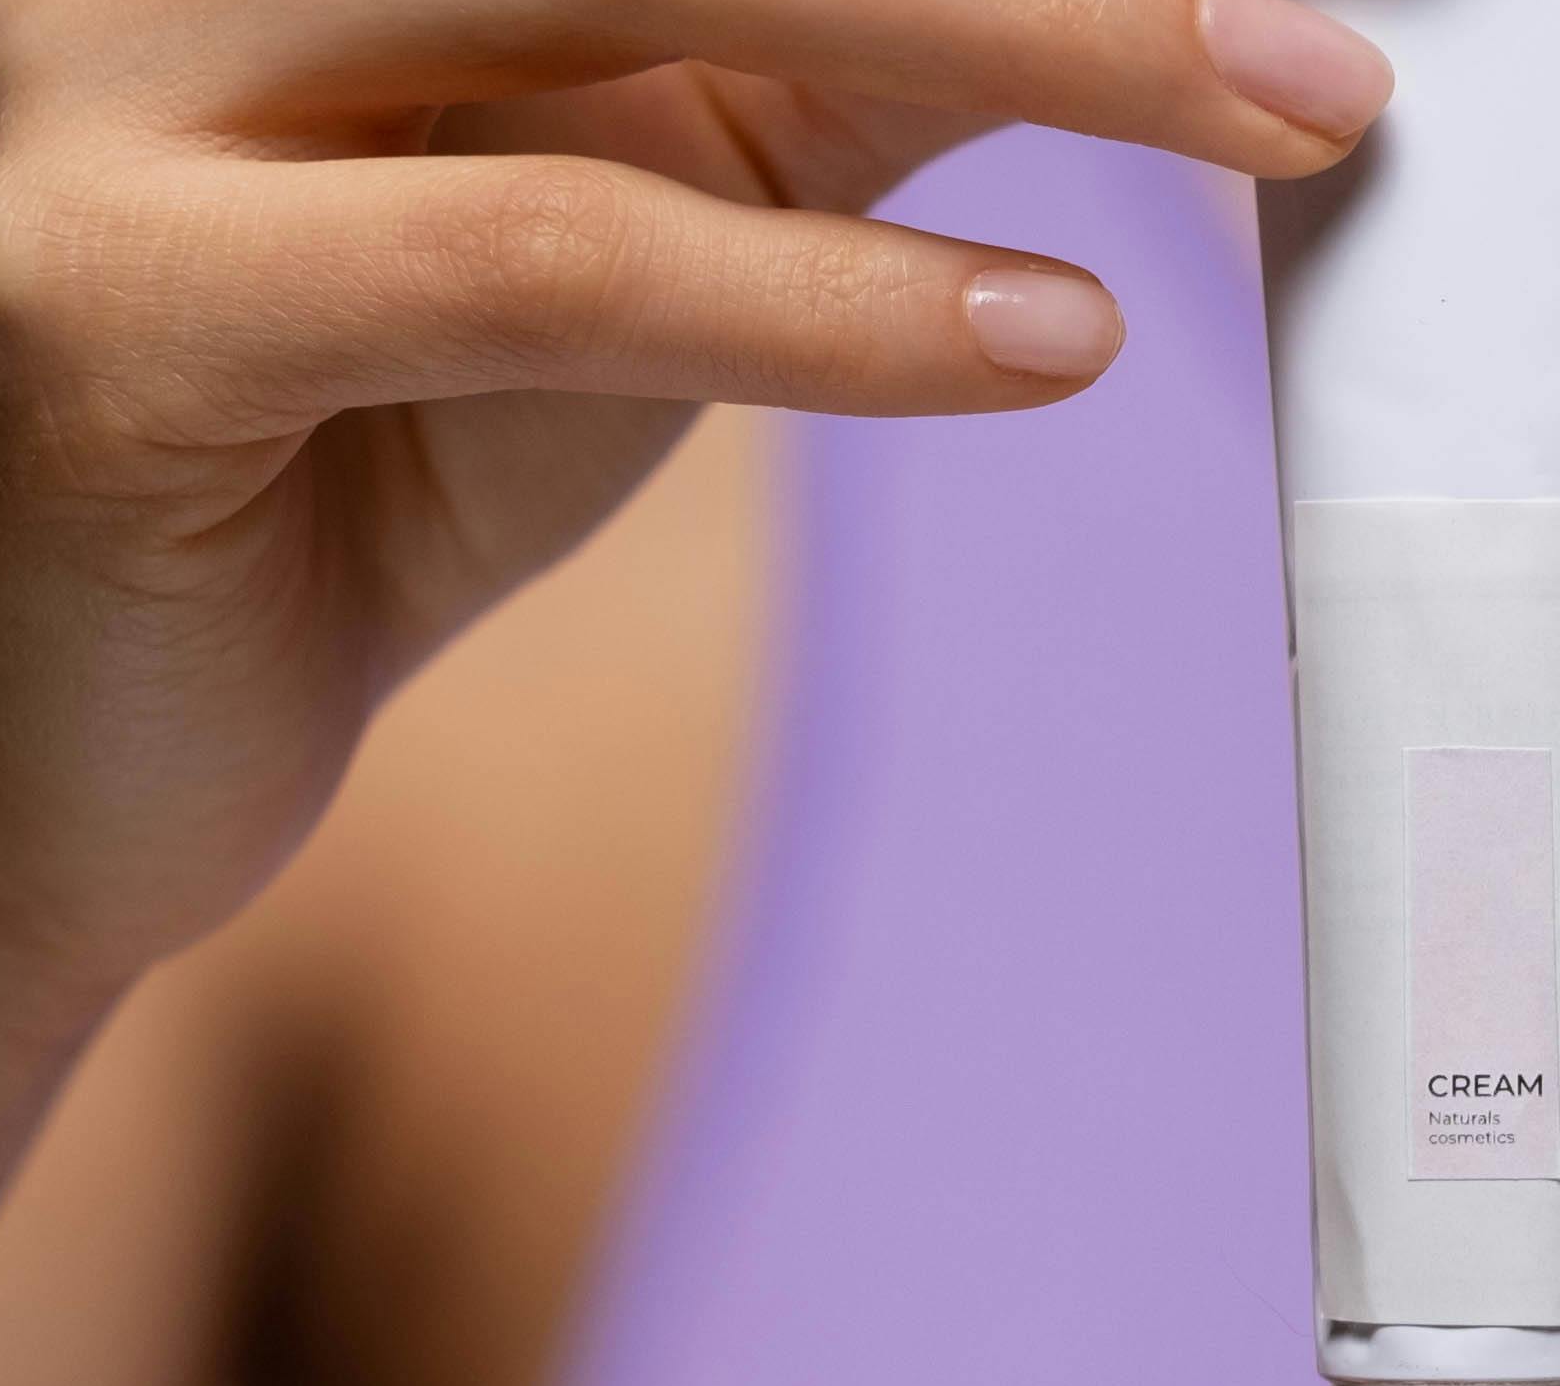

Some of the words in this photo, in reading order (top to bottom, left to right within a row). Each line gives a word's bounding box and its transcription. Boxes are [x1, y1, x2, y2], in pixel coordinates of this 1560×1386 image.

[1428, 1074, 1543, 1098] CREAM
[1428, 1110, 1501, 1126] Naturals
[1428, 1130, 1516, 1145] cosmetics
